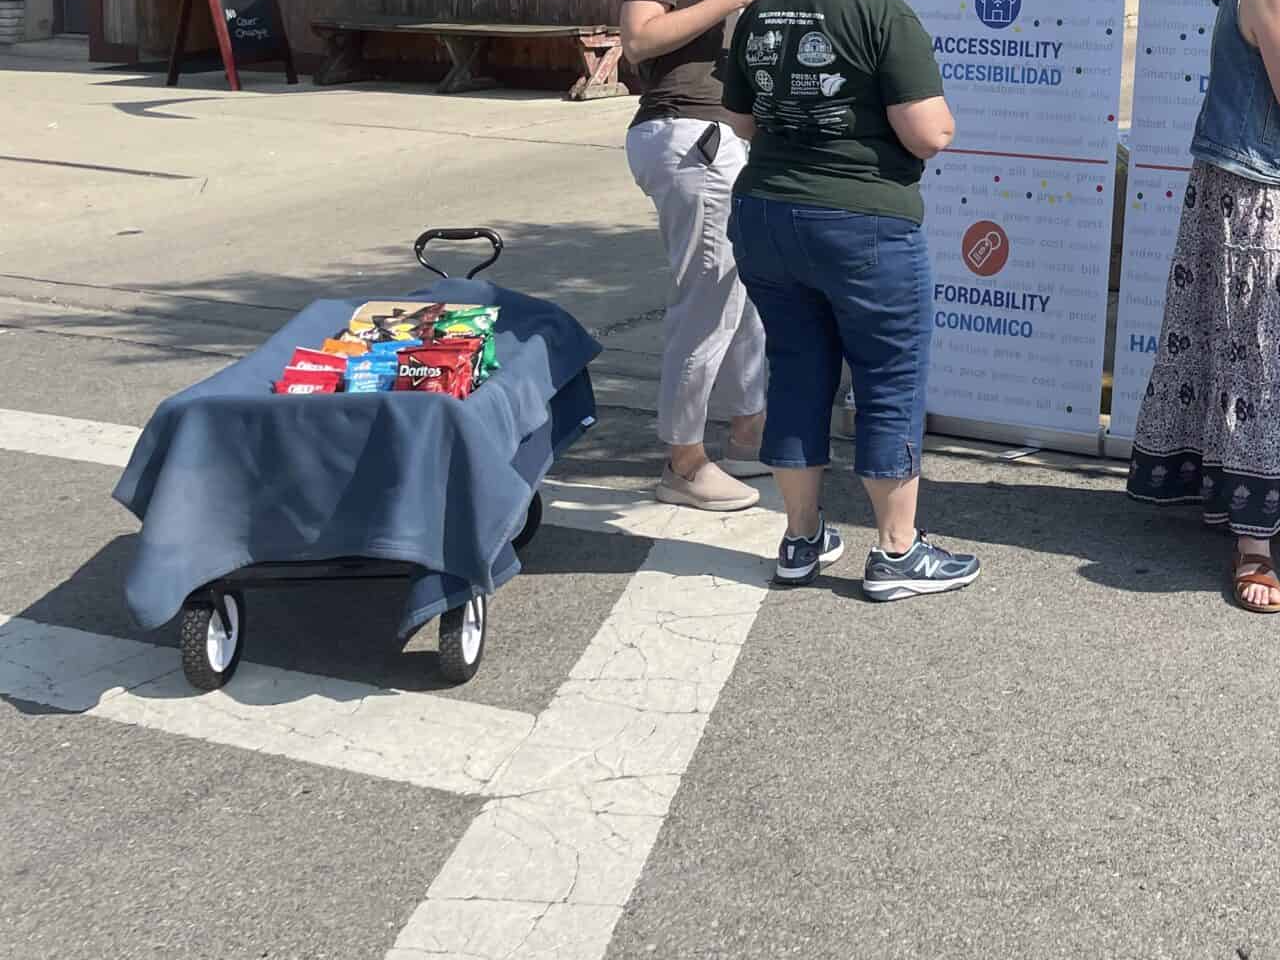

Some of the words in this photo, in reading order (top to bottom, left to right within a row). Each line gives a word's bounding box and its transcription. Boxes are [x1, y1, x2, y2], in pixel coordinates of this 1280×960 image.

[932, 35, 1064, 61] ACCESSIBILITY
[941, 62, 1062, 86] CCESIBILIDAD
[934, 283, 1051, 313] FORDABILITY
[934, 311, 1034, 339] CONOMICO
[399, 363, 443, 379] Doritos
